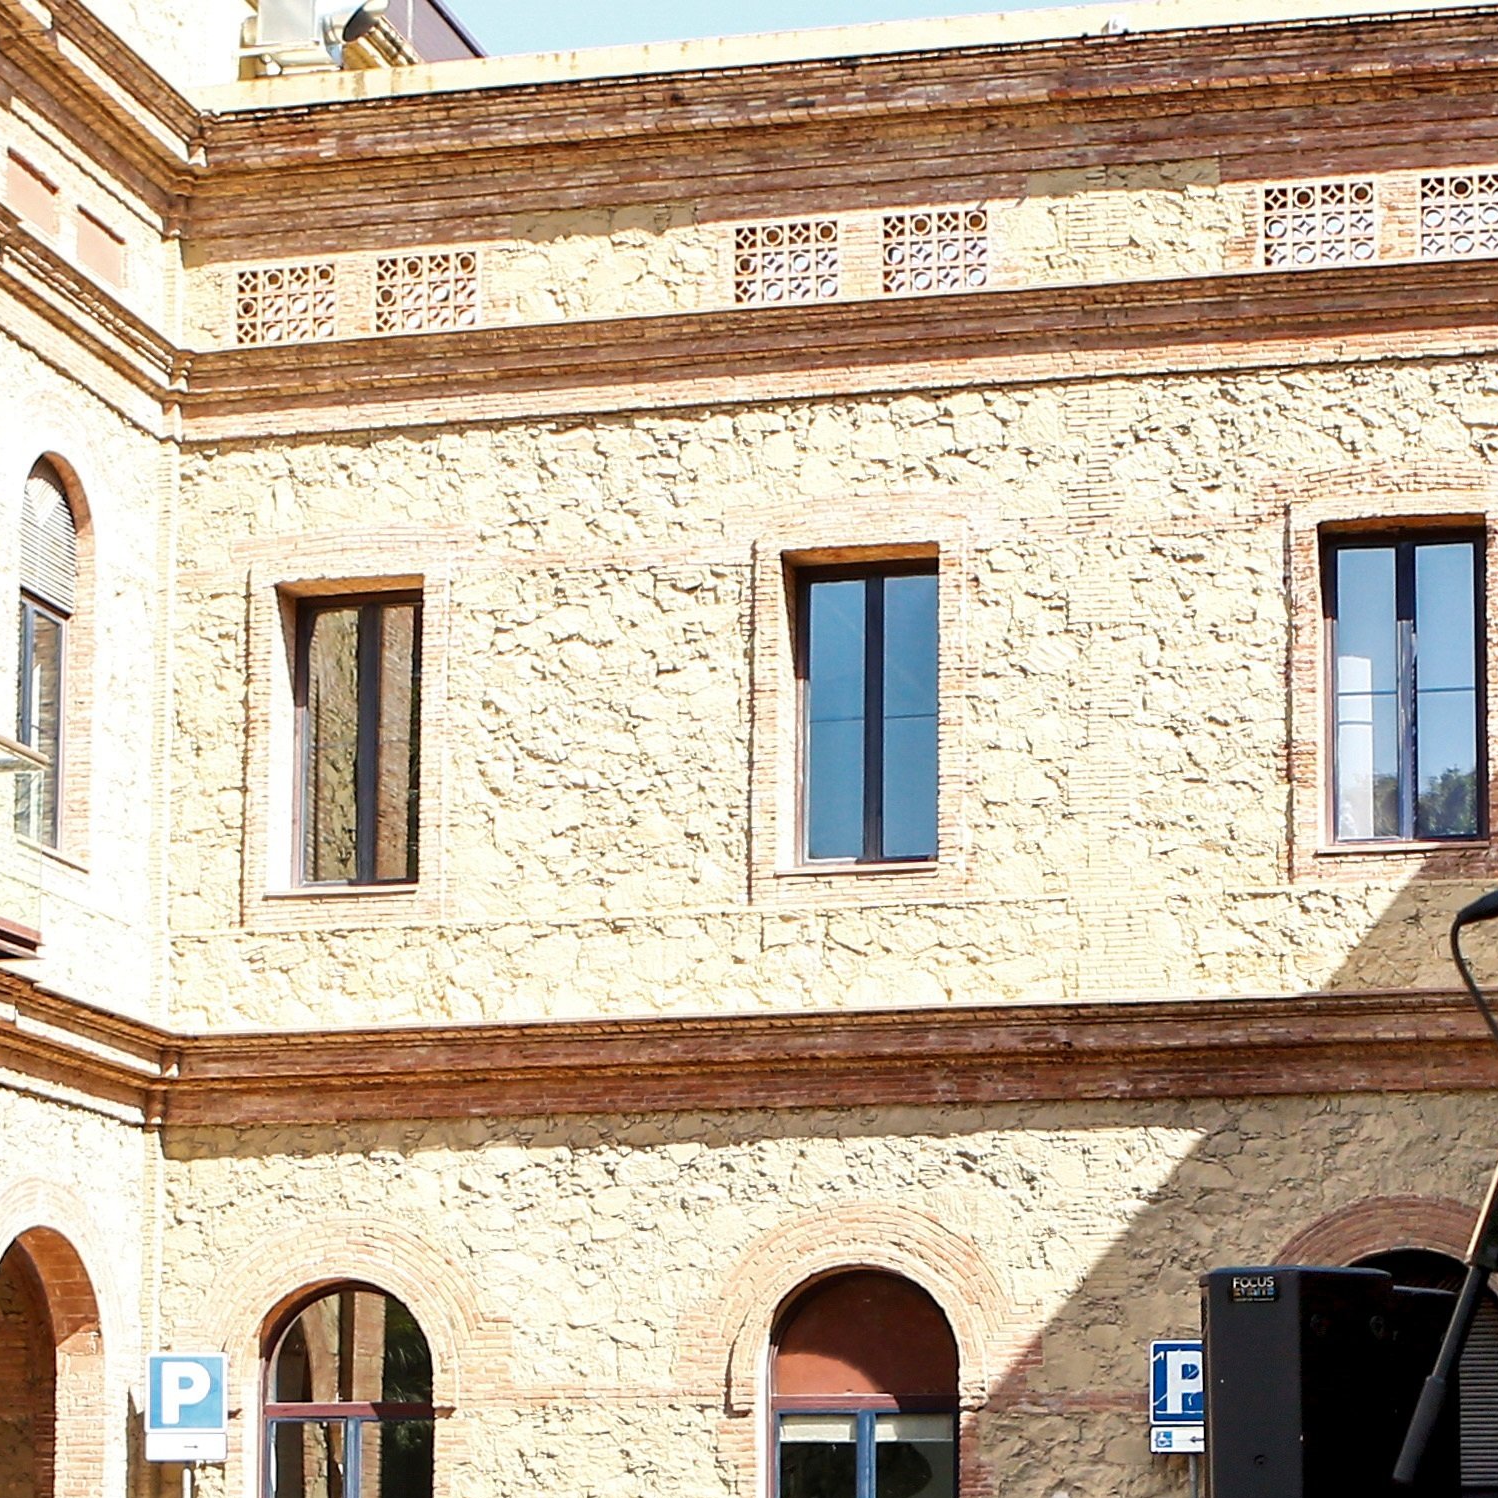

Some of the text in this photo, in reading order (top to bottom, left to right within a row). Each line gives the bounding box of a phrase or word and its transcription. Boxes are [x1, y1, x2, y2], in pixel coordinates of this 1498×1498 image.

[1232, 1275, 1275, 1288] FOCUS
[161, 1361, 211, 1425] P
[1166, 1350, 1204, 1414] P
